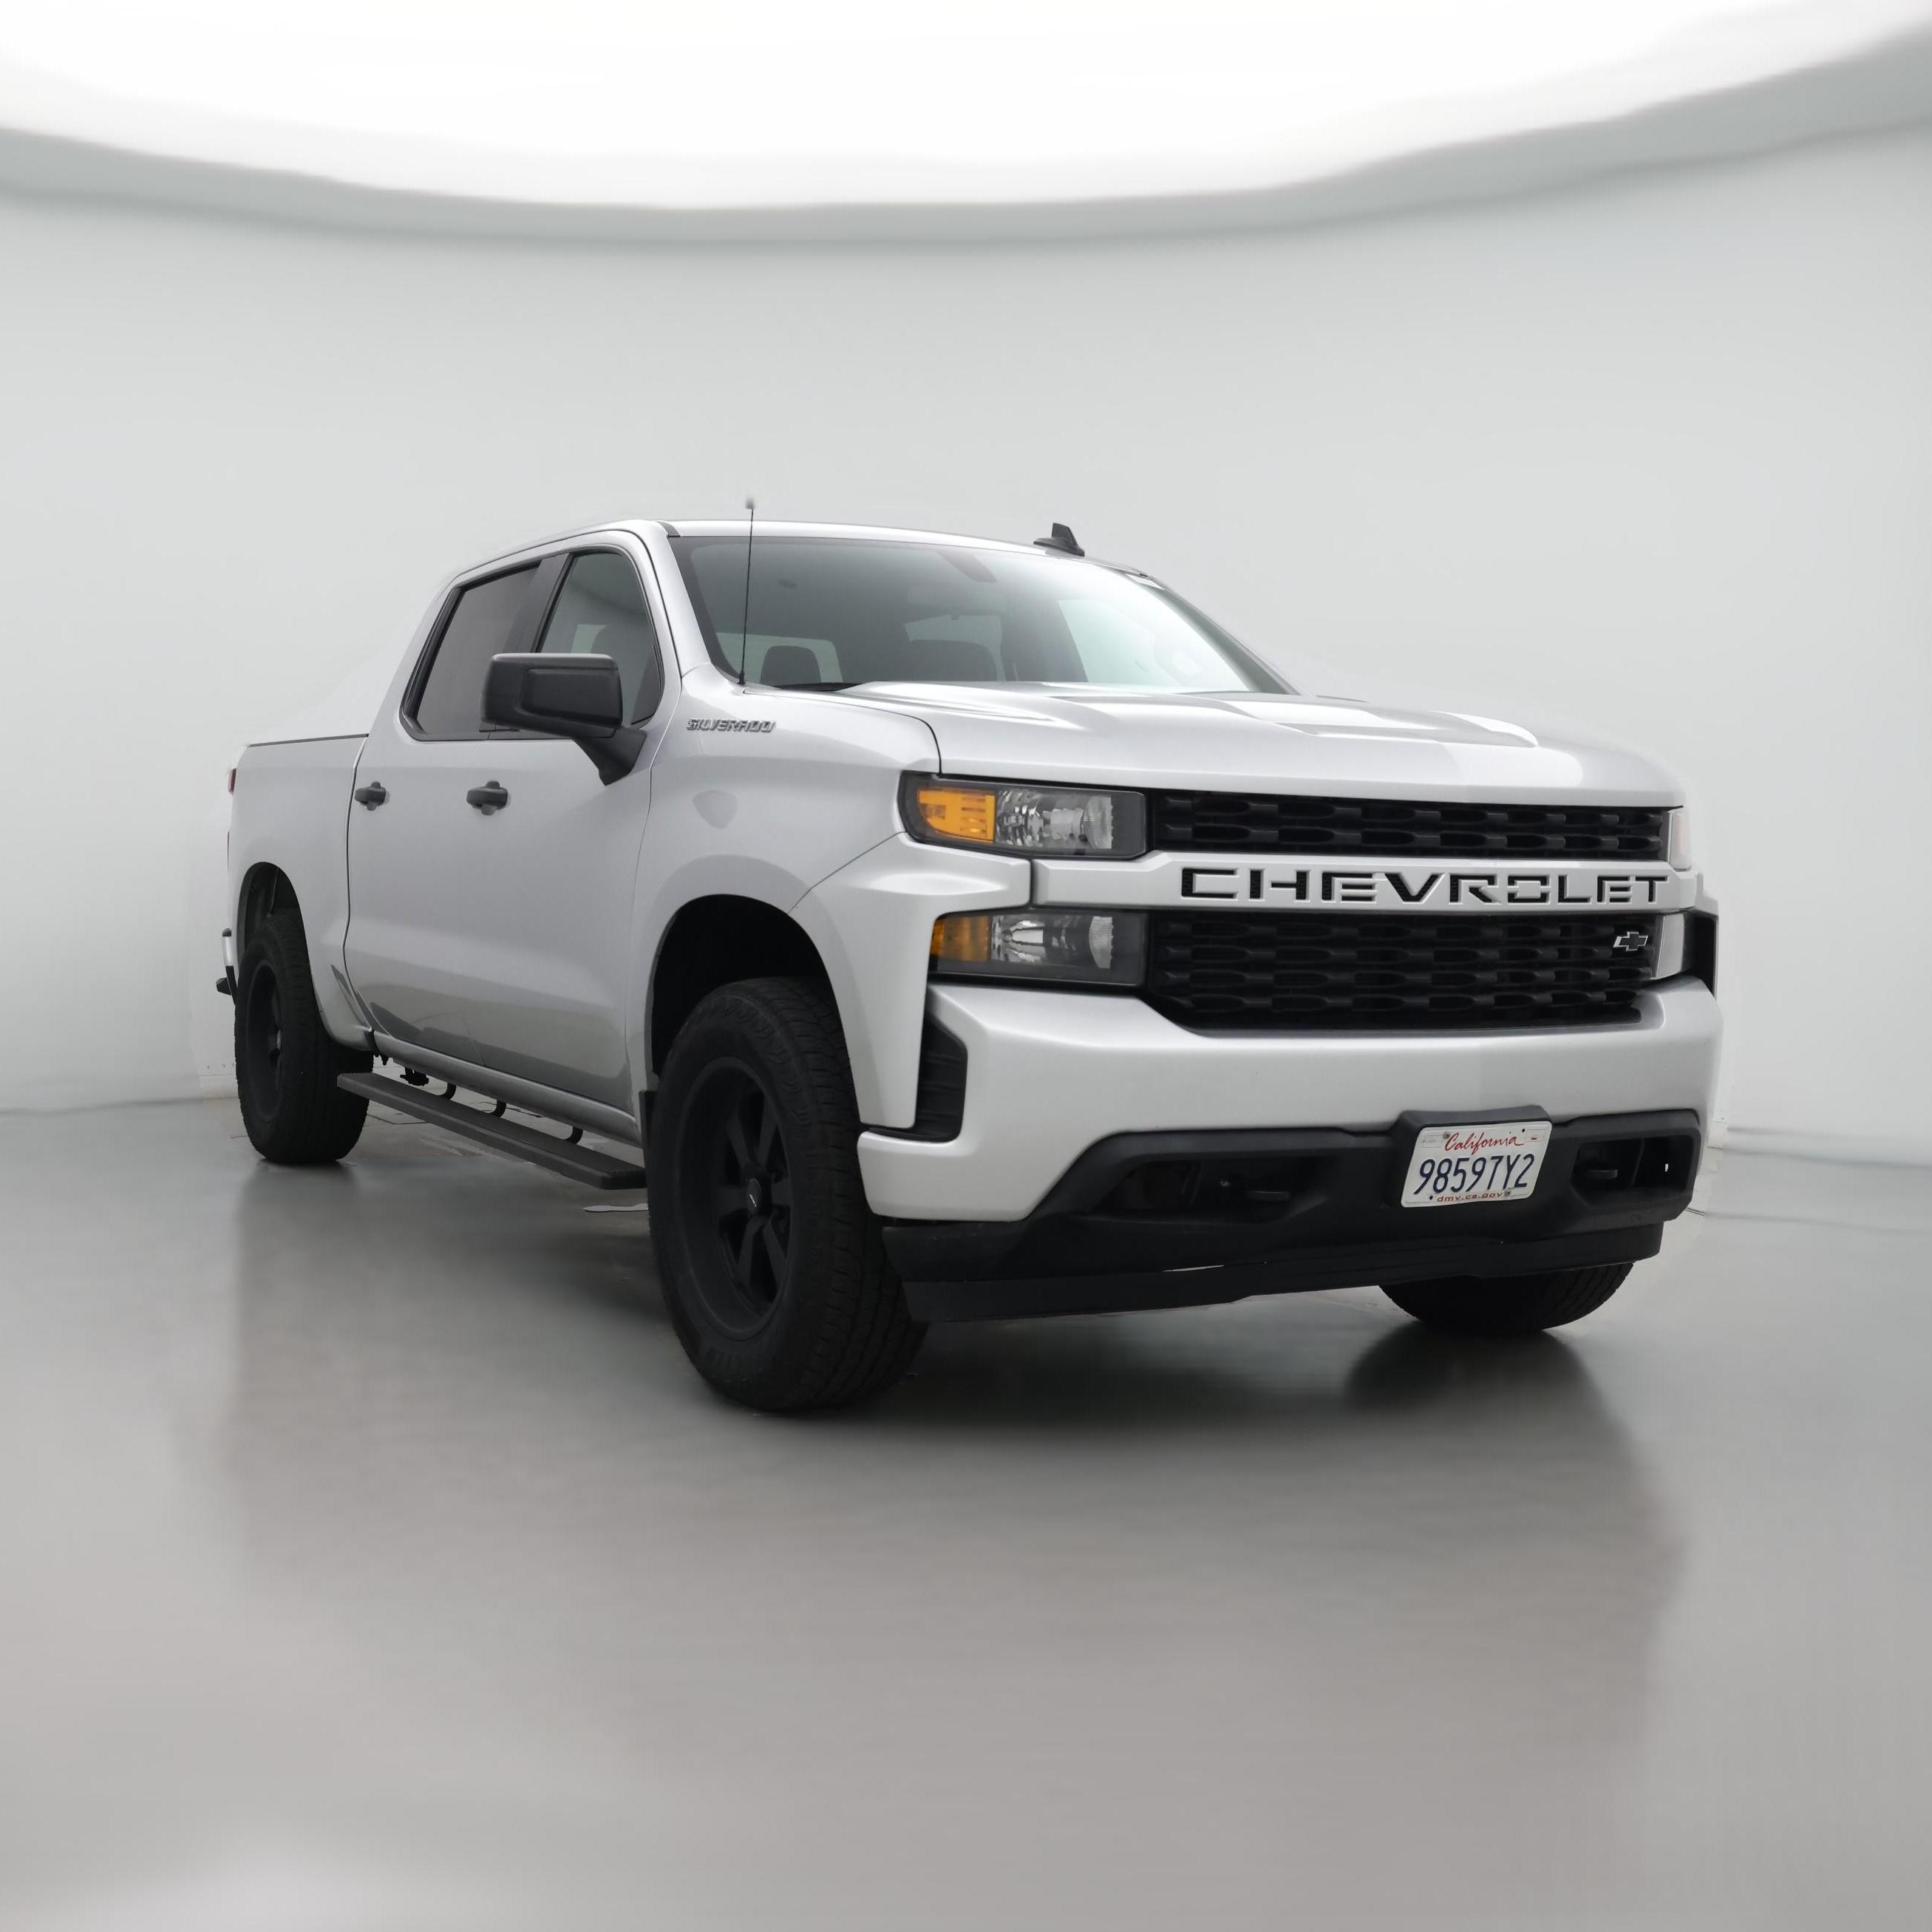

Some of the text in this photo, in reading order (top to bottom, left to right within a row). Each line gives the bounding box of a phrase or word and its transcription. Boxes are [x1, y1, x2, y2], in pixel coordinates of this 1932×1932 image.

[686, 718, 775, 732] SILVERADO
[1181, 868, 1668, 904] CHEVROLET
[1444, 1132, 1525, 1154] California
[1413, 1153, 1535, 1194] 98597Y2
[1437, 1191, 1503, 1203] dmv.ca.gov
